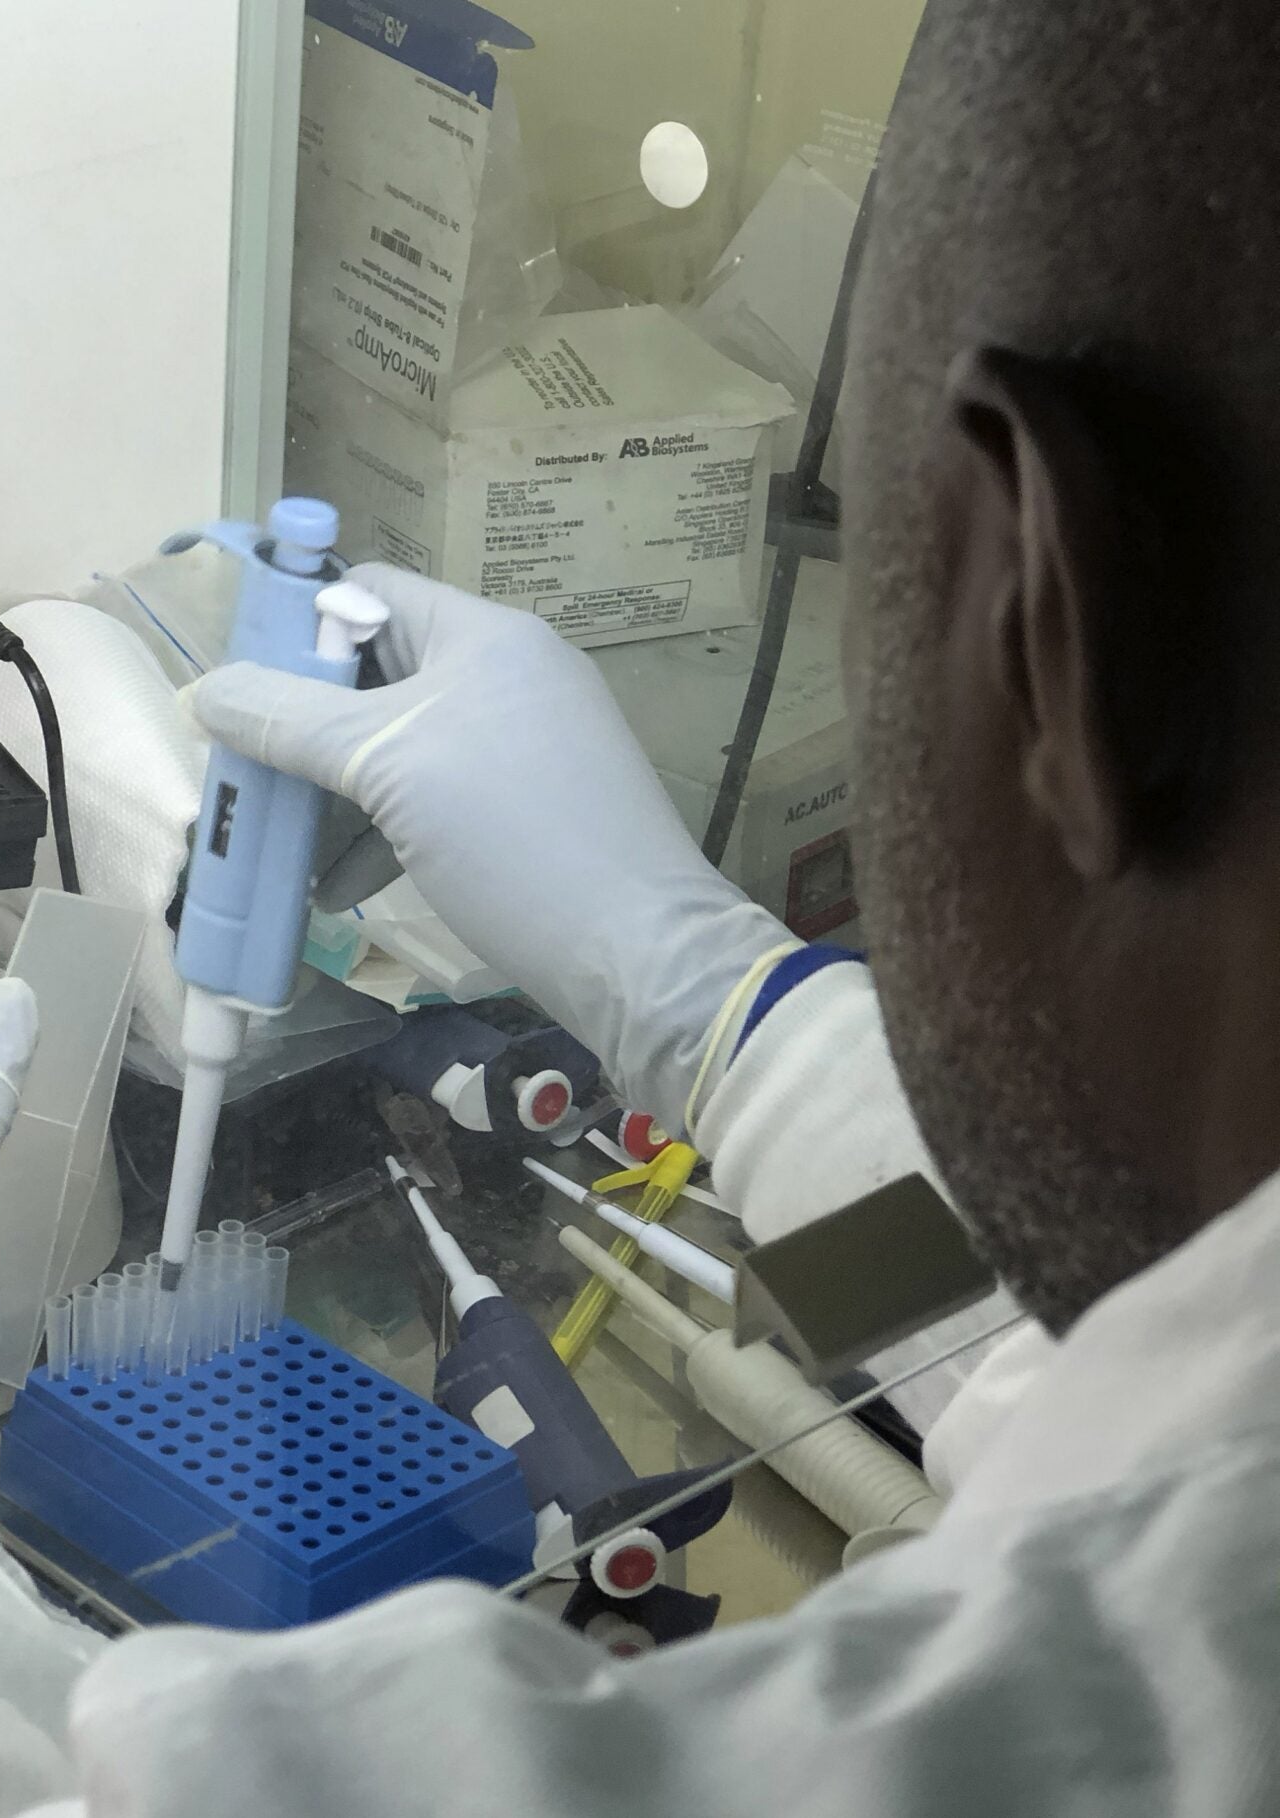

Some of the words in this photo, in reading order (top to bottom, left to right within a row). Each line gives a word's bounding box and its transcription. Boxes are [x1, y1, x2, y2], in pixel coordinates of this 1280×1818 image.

[363, 304, 383, 328] Strip
[384, 318, 412, 345] 8-Tube
[412, 334, 440, 362] Optical
[652, 433, 694, 448] Applied
[651, 442, 709, 457] Biosystems
[535, 453, 589, 466] Distributed
[591, 451, 608, 463] By:
[554, 476, 572, 484] Drive
[528, 577, 558, 585] Australia
[574, 594, 586, 602] For
[582, 600, 624, 610] Emergency
